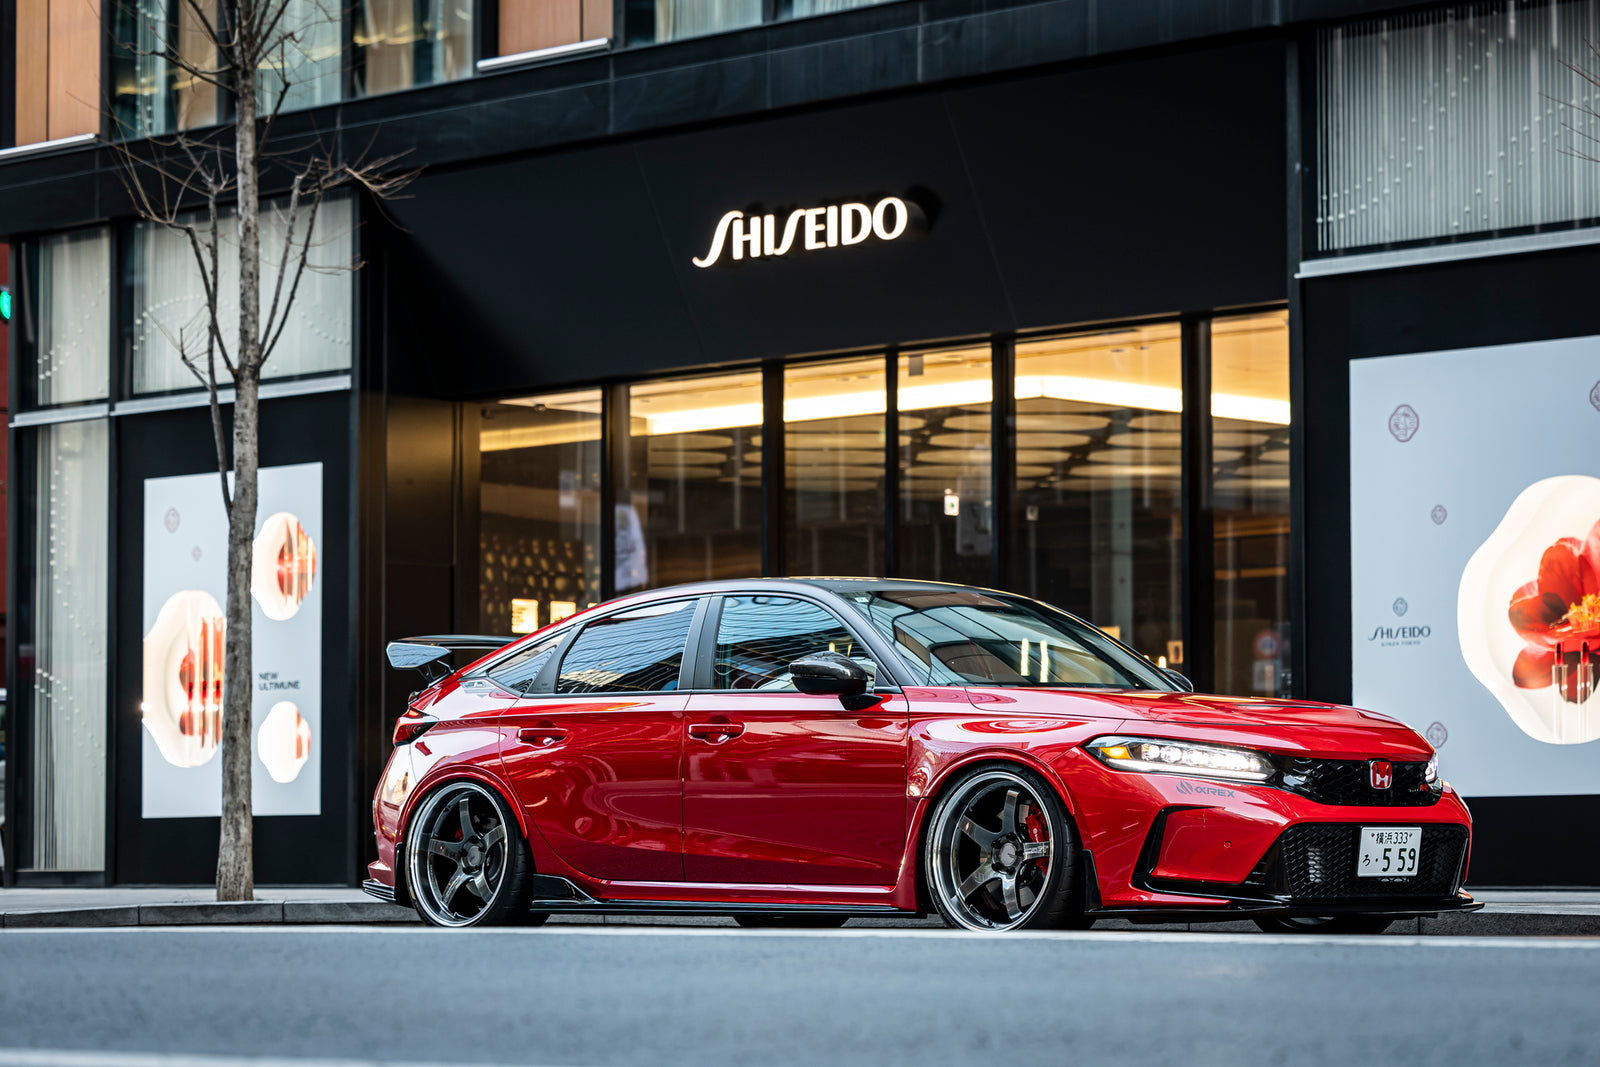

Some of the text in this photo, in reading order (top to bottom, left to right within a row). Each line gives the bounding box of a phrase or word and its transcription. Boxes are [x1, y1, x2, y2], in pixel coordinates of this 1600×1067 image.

[692, 197, 907, 268] SHISEIDO
[1368, 626, 1431, 641] SHISEIDO
[258, 672, 278, 680] NEW
[259, 681, 300, 691] ULTIMUNE
